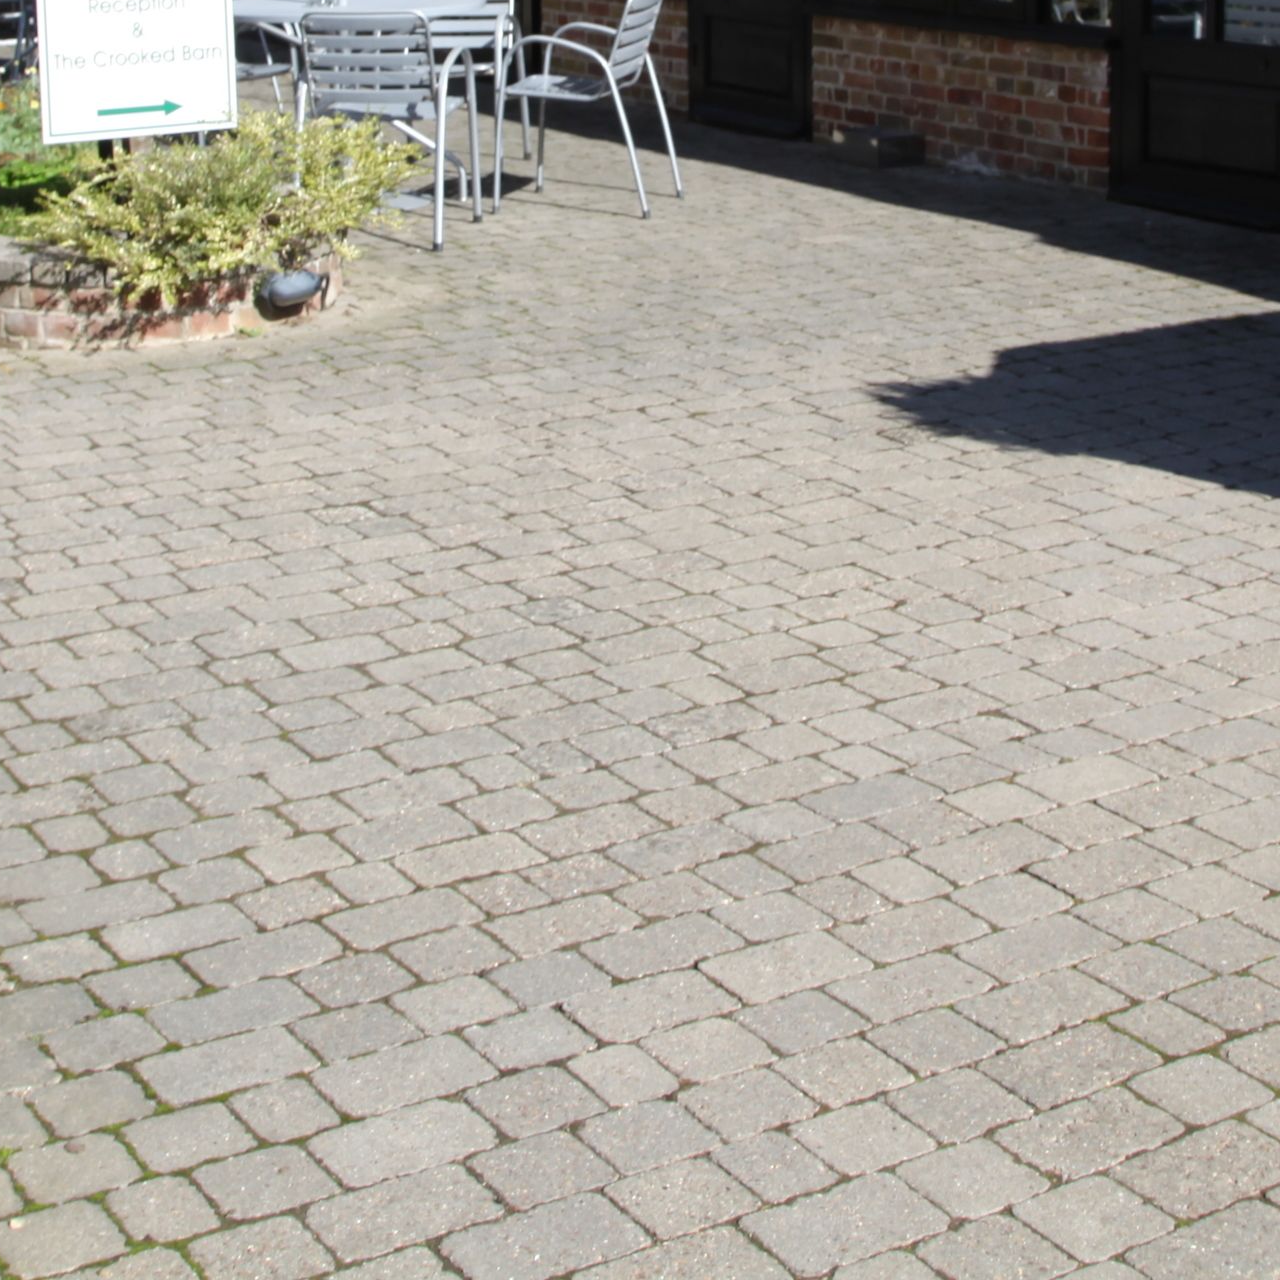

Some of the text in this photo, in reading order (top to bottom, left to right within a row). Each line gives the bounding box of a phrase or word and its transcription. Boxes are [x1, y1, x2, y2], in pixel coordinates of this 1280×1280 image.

[132, 22, 144, 38] &
[54, 45, 222, 70] The Crooked Barn
